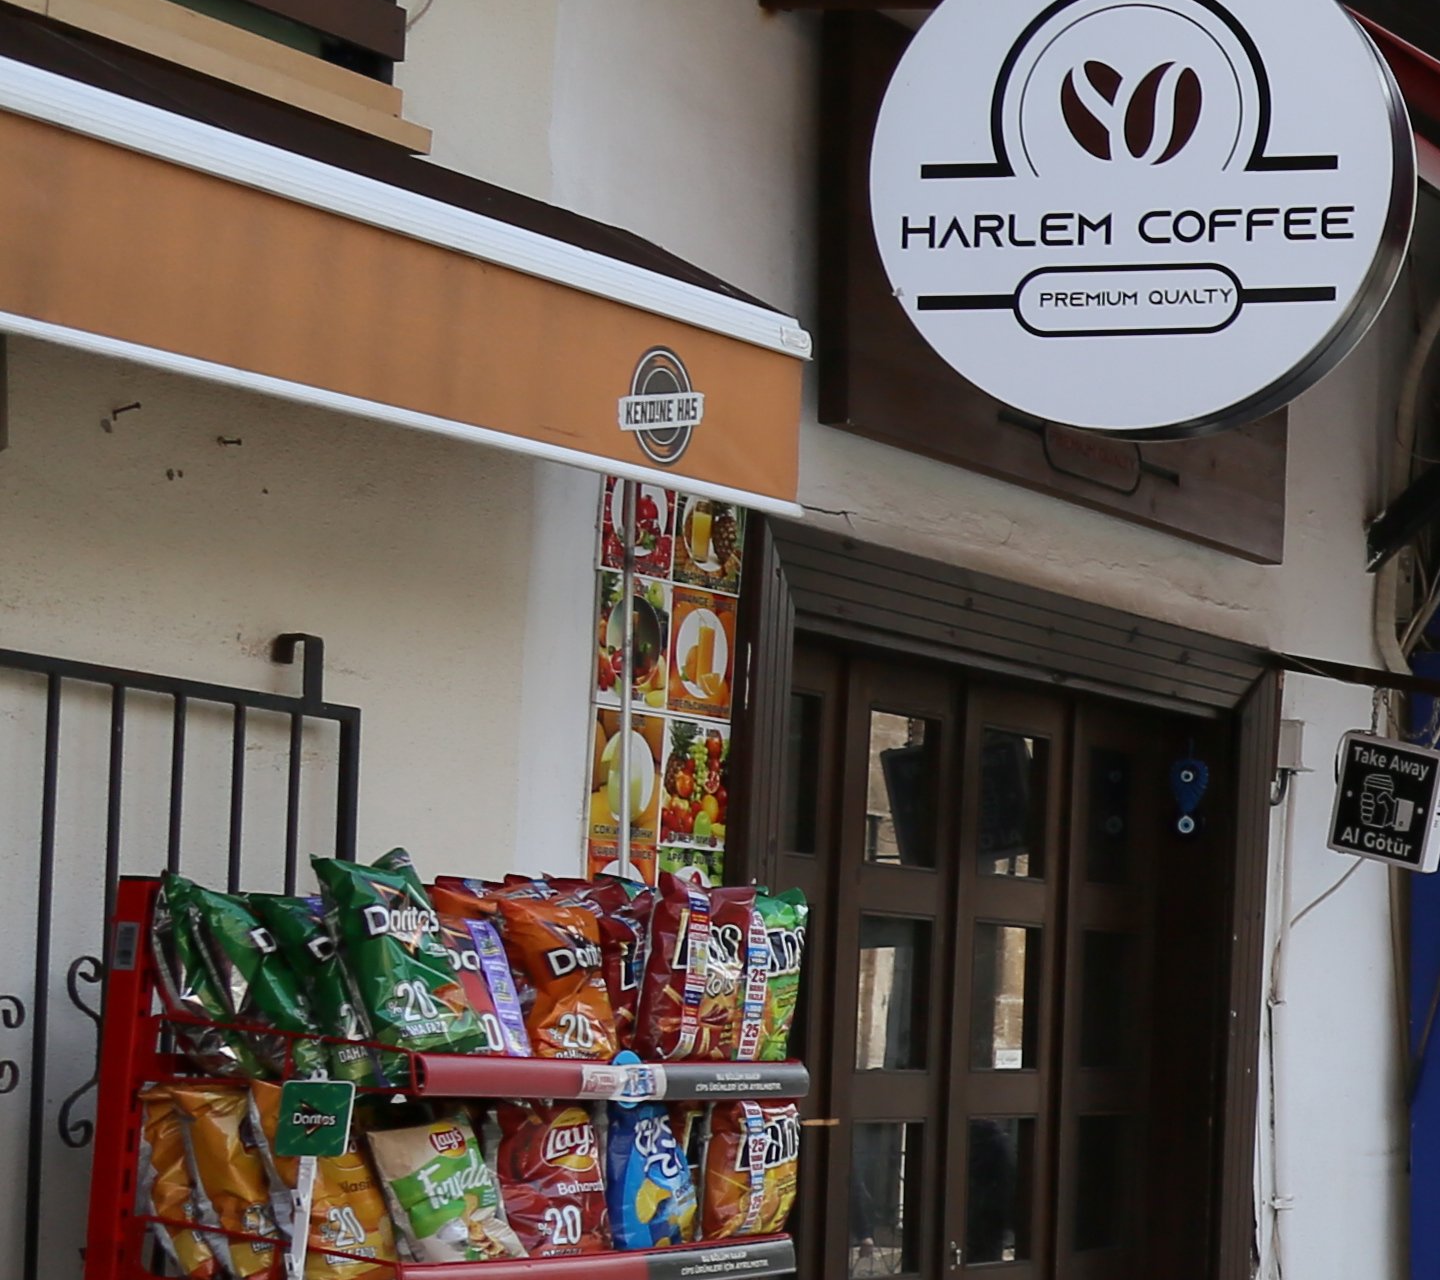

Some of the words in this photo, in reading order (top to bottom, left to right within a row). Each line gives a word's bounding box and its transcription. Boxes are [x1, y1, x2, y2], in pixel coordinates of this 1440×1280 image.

[901, 212, 1113, 249] HARLEM
[1138, 205, 1355, 244] COFFEE
[1039, 291, 1139, 308] PREMIUM
[1148, 287, 1234, 305] QUALTY
[676, 397, 698, 421] HAS
[1354, 746, 1387, 768] Take
[1389, 755, 1430, 781] Away
[1341, 826, 1360, 844] Al
[1363, 831, 1413, 857] Götür
[363, 904, 440, 936] Doritos
[292, 1111, 336, 1127] Doritos
[431, 1126, 462, 1151] Lay's
